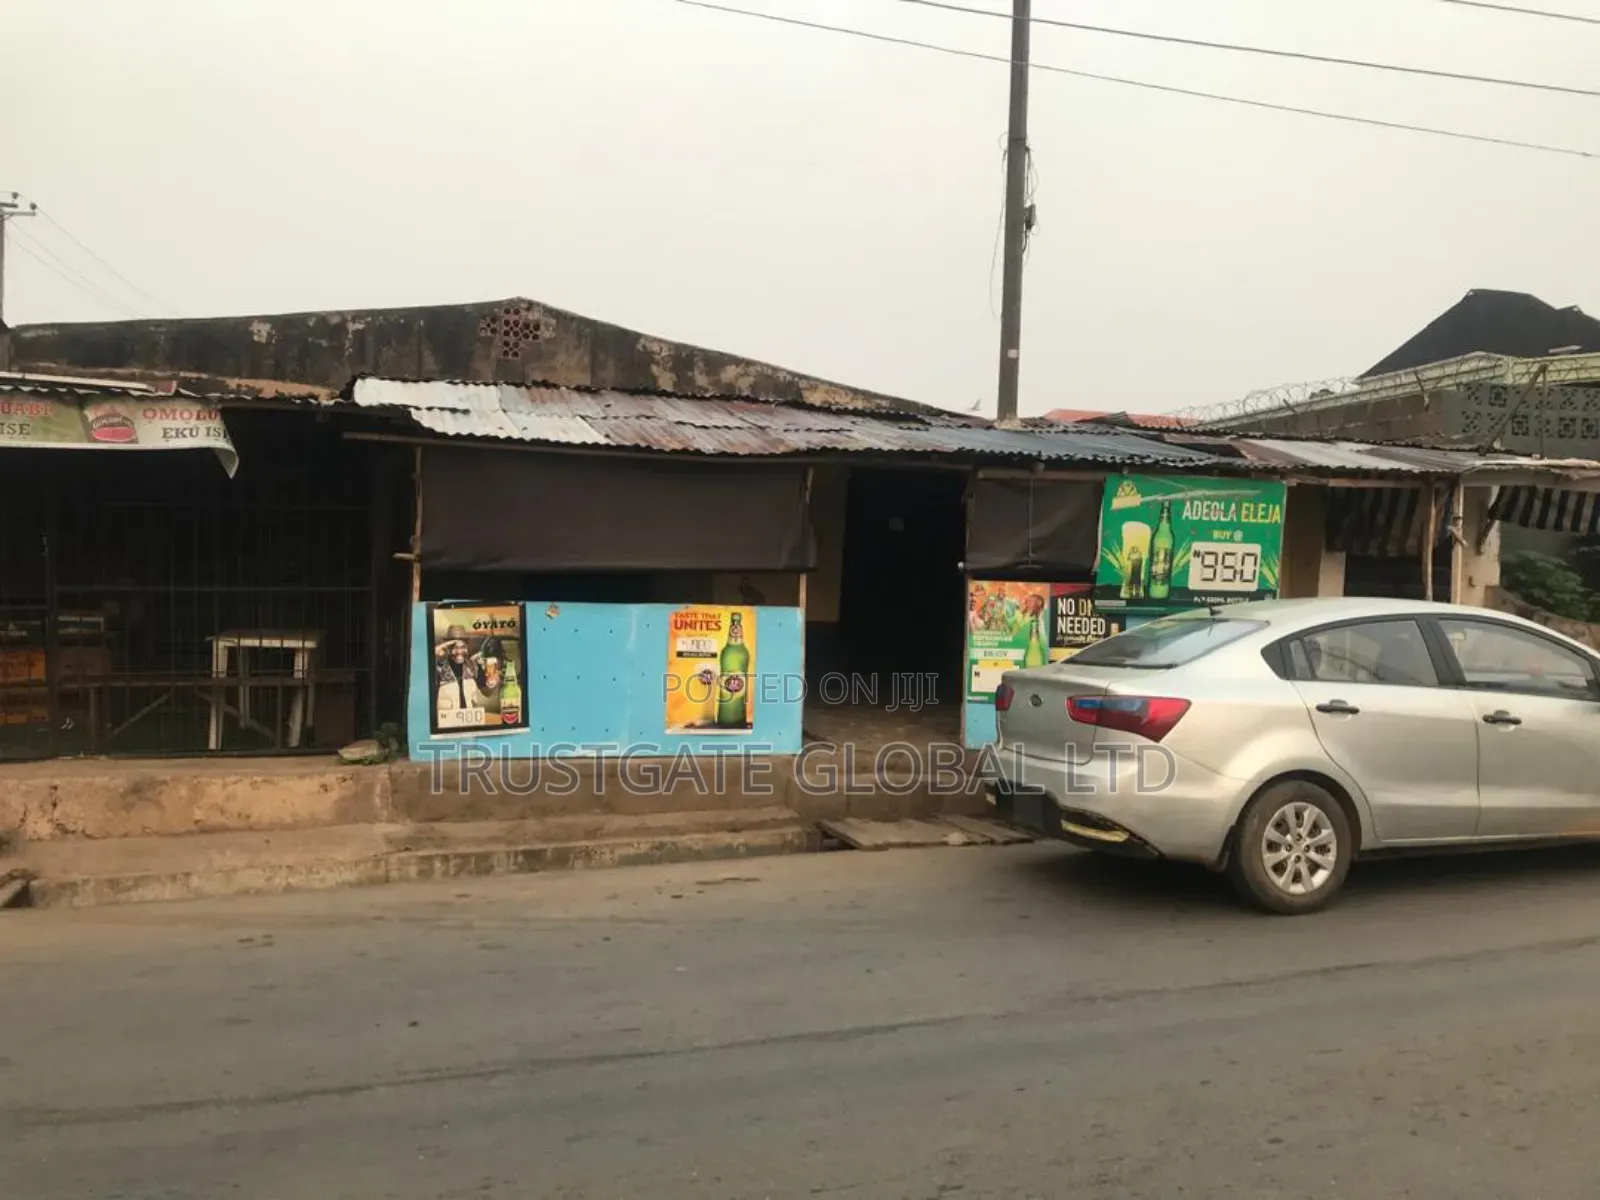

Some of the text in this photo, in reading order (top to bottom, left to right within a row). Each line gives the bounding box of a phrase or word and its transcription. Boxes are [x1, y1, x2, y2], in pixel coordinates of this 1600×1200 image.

[1182, 500, 1281, 524] ADEOLA ELEJA
[1057, 598, 1075, 616] NO
[673, 619, 722, 631] UNITES
[1057, 616, 1106, 635] NEEDED
